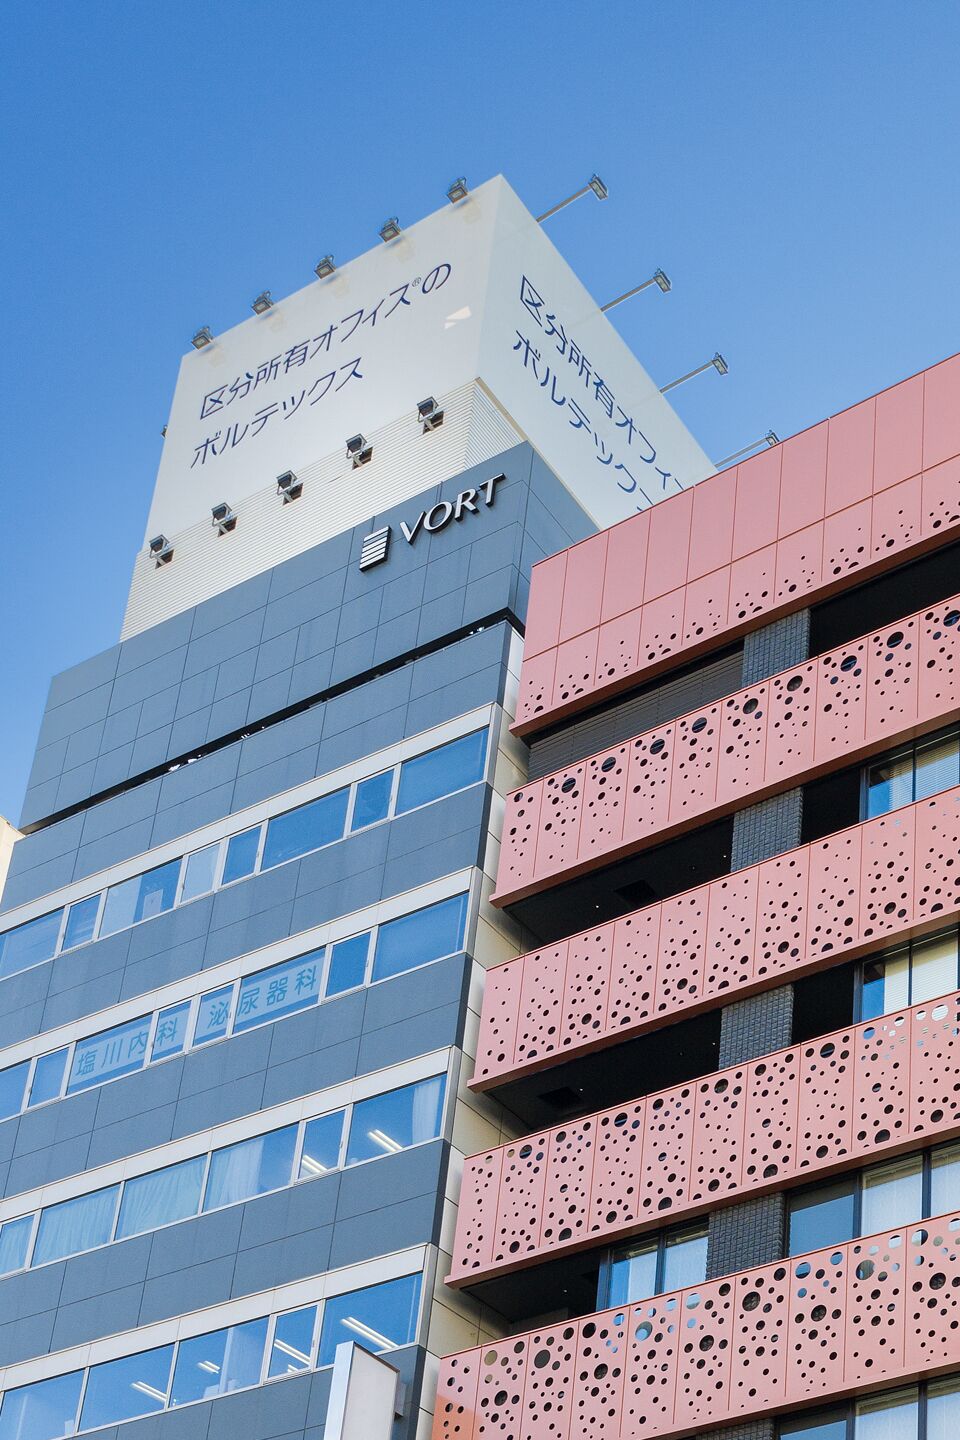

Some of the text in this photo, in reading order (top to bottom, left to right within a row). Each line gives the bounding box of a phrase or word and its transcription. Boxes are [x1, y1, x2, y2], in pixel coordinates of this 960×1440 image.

[190, 356, 363, 469] ボルテックス
[520, 275, 685, 491] 区分所有オフィ
[400, 472, 507, 545] VORT
[75, 1016, 178, 1077] 塩川内科
